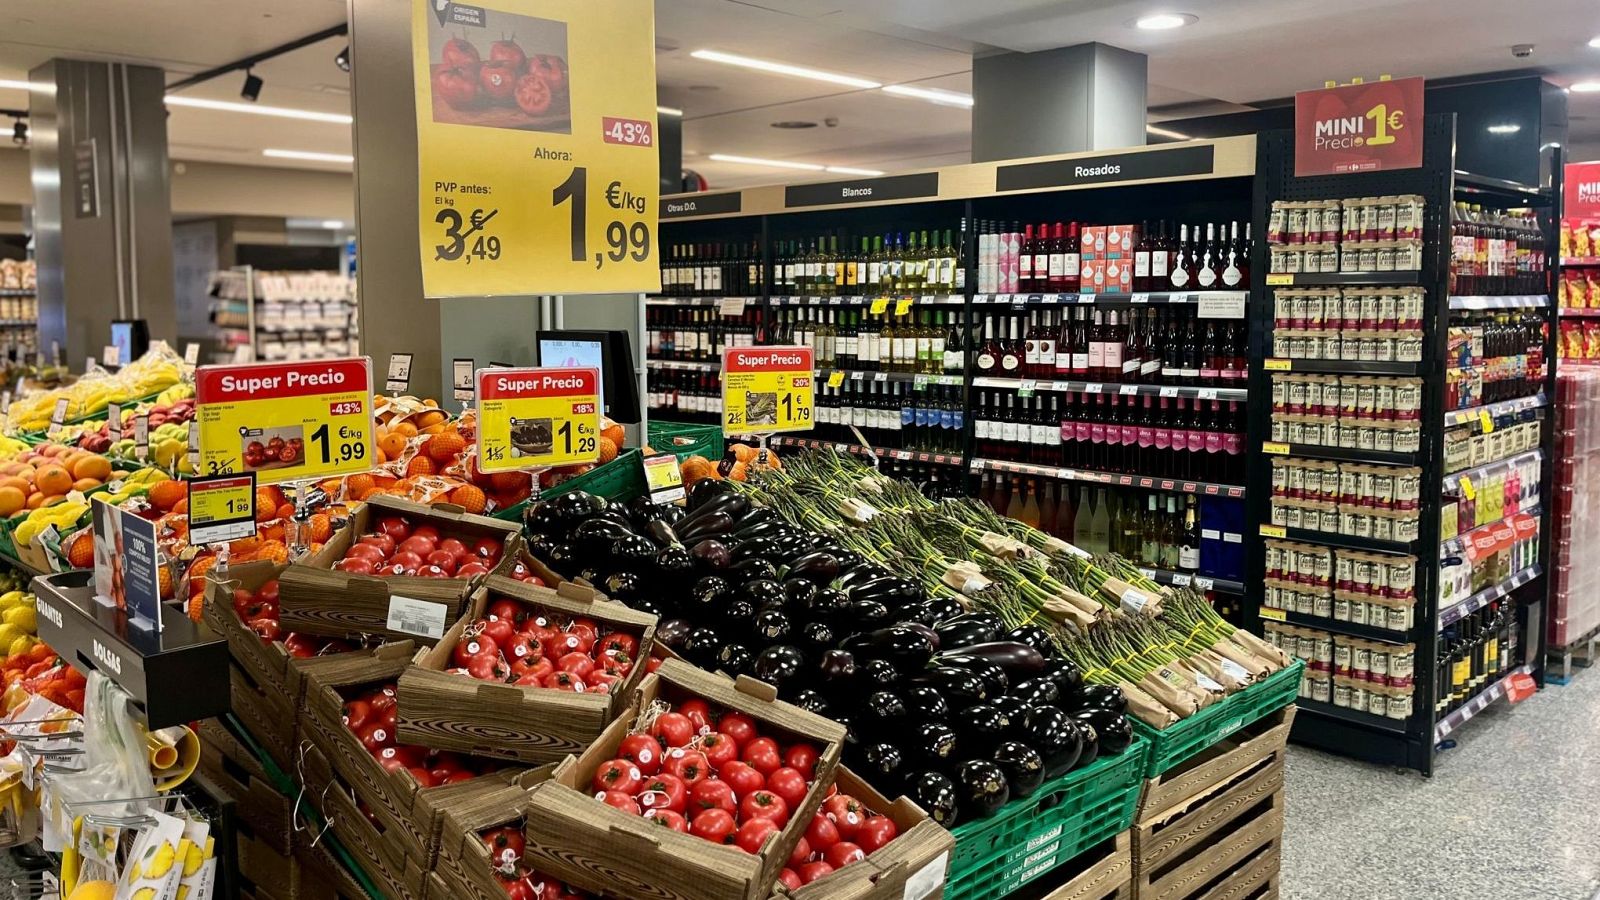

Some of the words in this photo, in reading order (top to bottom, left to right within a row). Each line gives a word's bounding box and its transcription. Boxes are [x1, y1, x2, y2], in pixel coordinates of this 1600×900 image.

[453, 6, 479, 16] ORIGEN
[453, 13, 481, 24] ESPAÑA
[605, 121, 650, 145] -43%
[1315, 116, 1364, 137] MINI
[1315, 134, 1364, 151] Precio
[534, 147, 573, 162] Ahora:
[1075, 163, 1121, 178] Rosados
[435, 181, 458, 194] PVP
[460, 183, 492, 195] antes:
[842, 186, 872, 197] Blancos
[435, 197, 442, 205] El
[444, 197, 455, 207] kg
[605, 181, 646, 214] €/kg
[667, 203, 682, 213] Otras
[684, 202, 697, 212] D.O.
[552, 166, 650, 270] 1,99
[738, 355, 769, 368] Super
[771, 353, 802, 365] Precio
[221, 374, 282, 393] Super
[286, 368, 345, 387] Precio
[497, 377, 540, 392] Super
[542, 375, 584, 389] Precio
[793, 379, 809, 387] -20%
[796, 395, 802, 404] €
[331, 402, 361, 414] -43%
[573, 404, 594, 413] -18%
[782, 392, 810, 423] 1,79
[339, 426, 362, 439] €/kg
[577, 423, 595, 435] €/kg
[311, 424, 365, 465] 1,99
[558, 420, 596, 456] 1,29
[226, 499, 234, 514] 1
[237, 503, 249, 513] 99
[36, 596, 63, 629] GUANTES
[93, 638, 121, 675] BOLSAS
